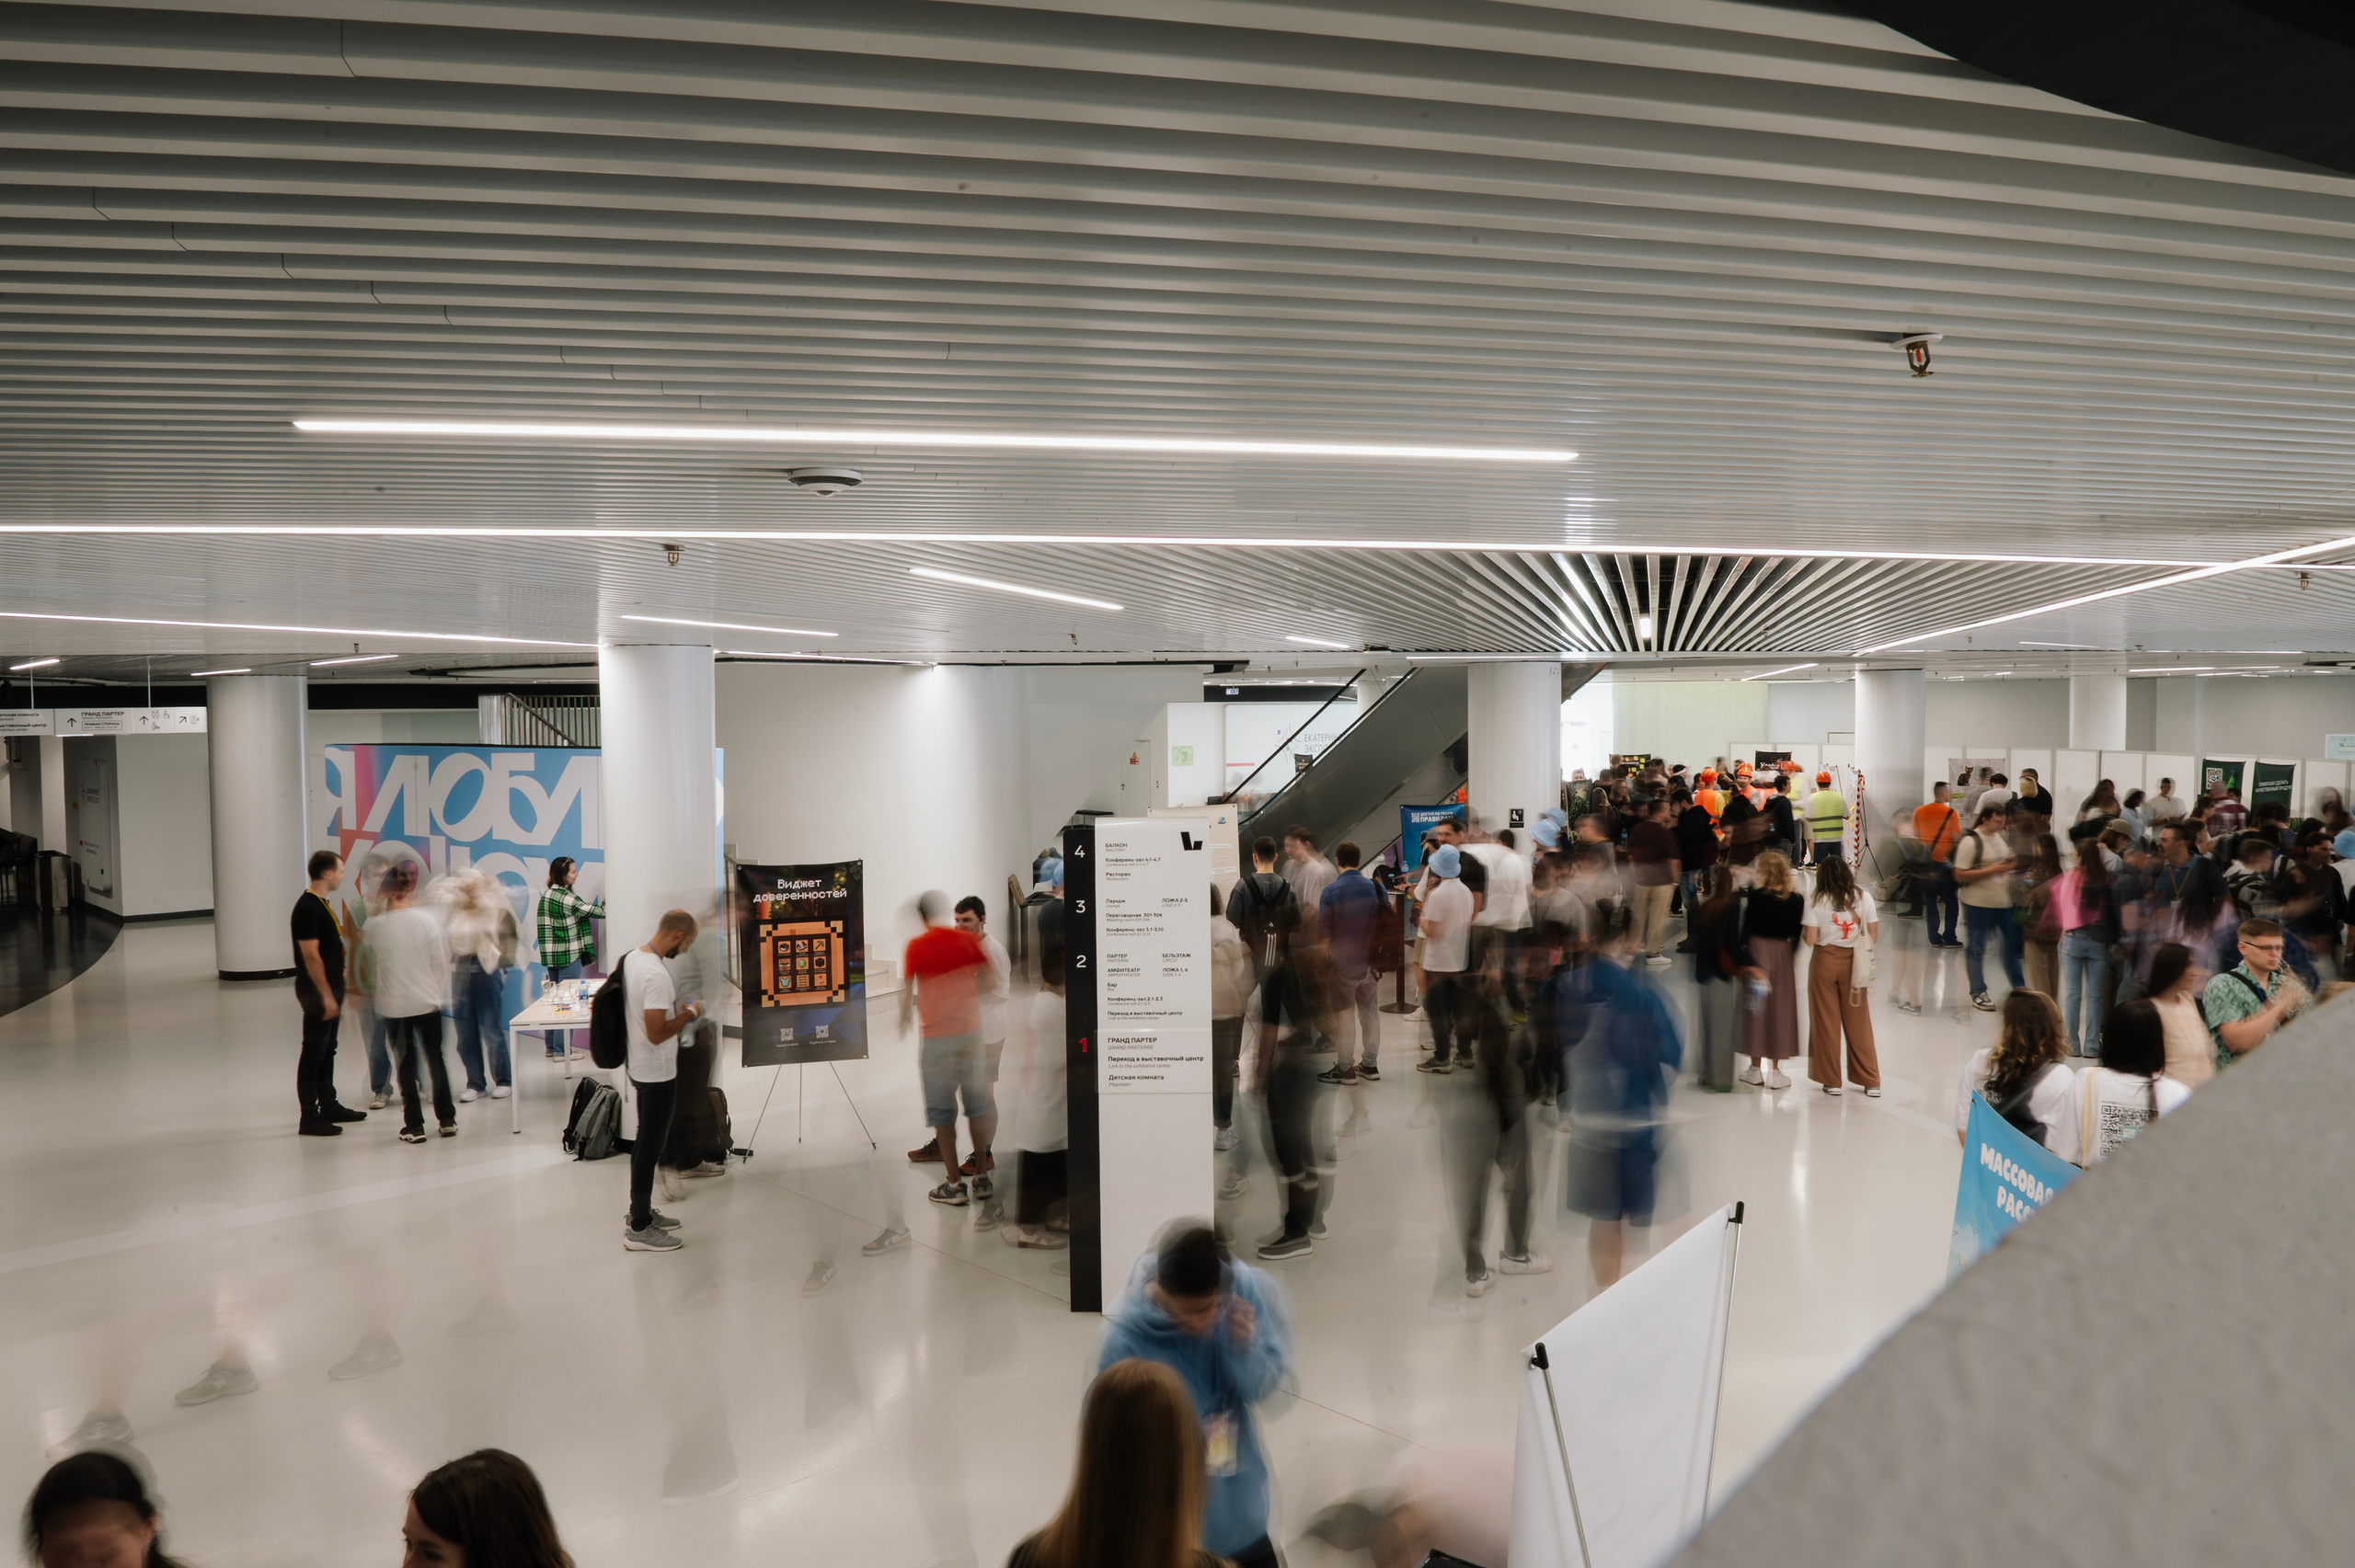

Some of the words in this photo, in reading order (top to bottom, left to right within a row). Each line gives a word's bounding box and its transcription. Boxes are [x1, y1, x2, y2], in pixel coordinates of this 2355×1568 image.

[1304, 734, 1340, 742] ЕКАТЕРИН
[363, 752, 604, 850] ЛЮБЛ
[1074, 845, 1086, 858] 4
[777, 879, 821, 889] Виджет
[753, 888, 846, 903] доверенностей
[1075, 900, 1086, 913] 3
[1076, 955, 1086, 967] 2
[1079, 1038, 1087, 1053] 1
